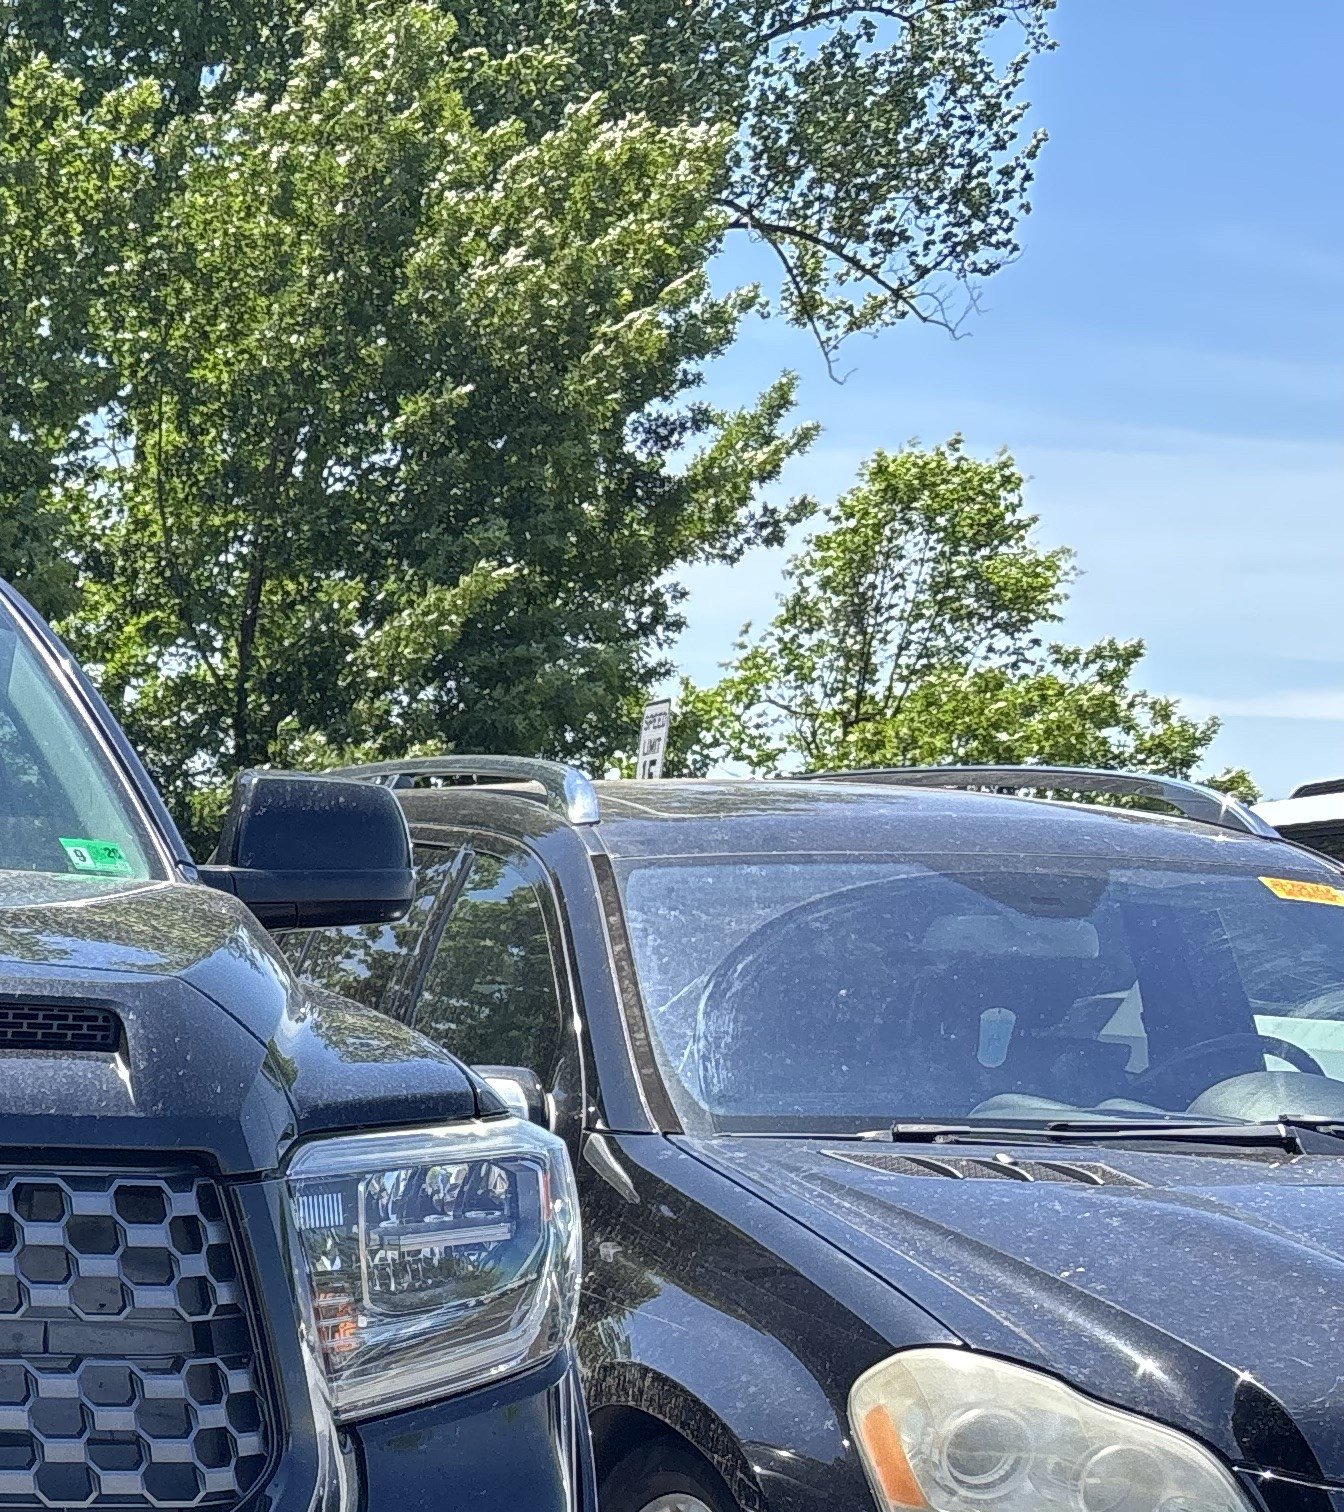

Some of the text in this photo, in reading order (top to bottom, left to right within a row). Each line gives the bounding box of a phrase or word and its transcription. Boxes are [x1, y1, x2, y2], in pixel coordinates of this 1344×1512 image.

[644, 712, 668, 732] SPEED
[642, 737, 662, 757] LIMIT
[73, 849, 87, 863] 9
